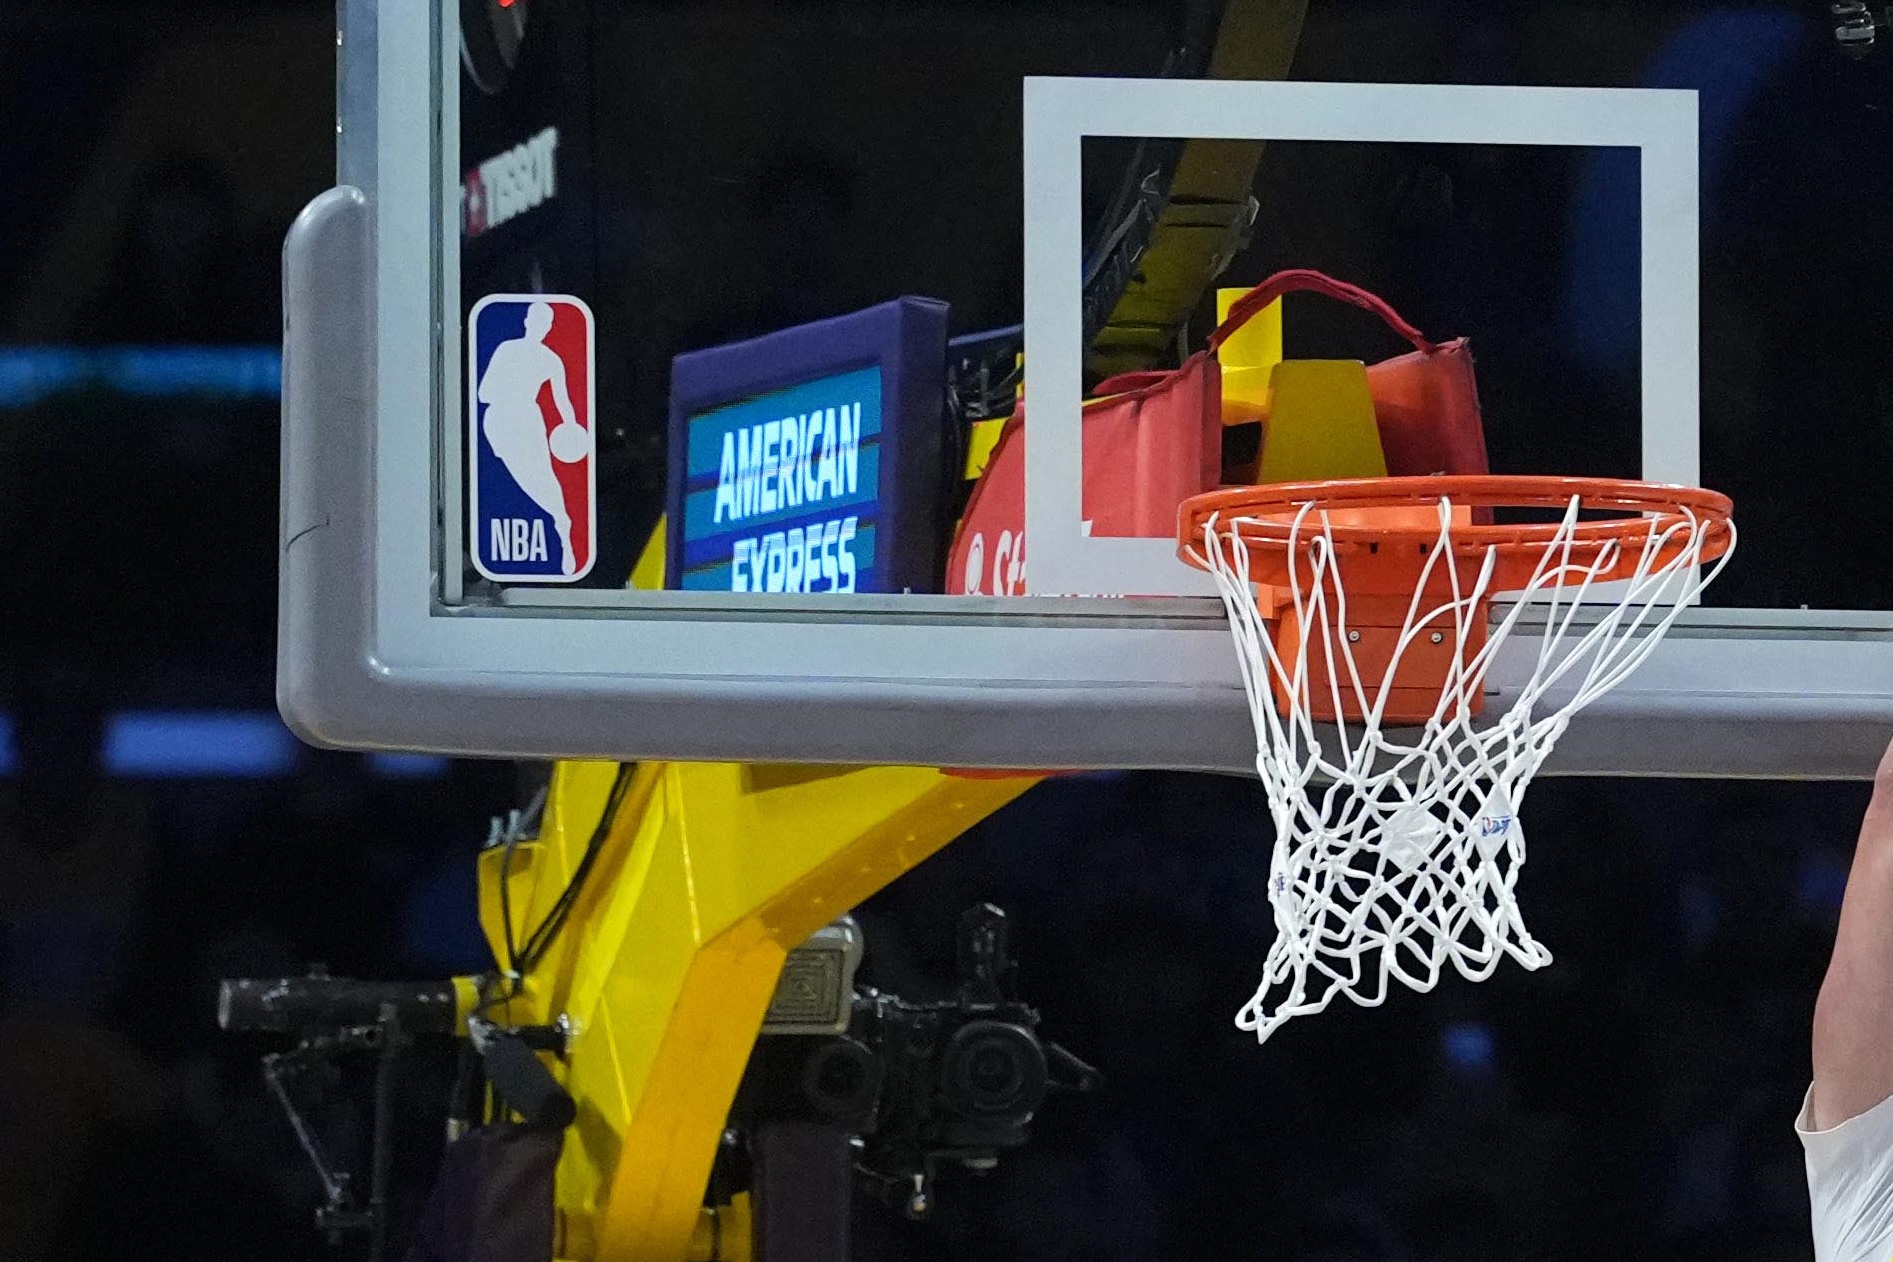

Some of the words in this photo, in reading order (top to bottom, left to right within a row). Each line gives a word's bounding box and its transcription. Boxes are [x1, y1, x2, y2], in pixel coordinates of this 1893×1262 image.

[713, 402, 861, 524] AMERICAN
[491, 518, 549, 562] NBA
[731, 516, 859, 594] EXPRESS
